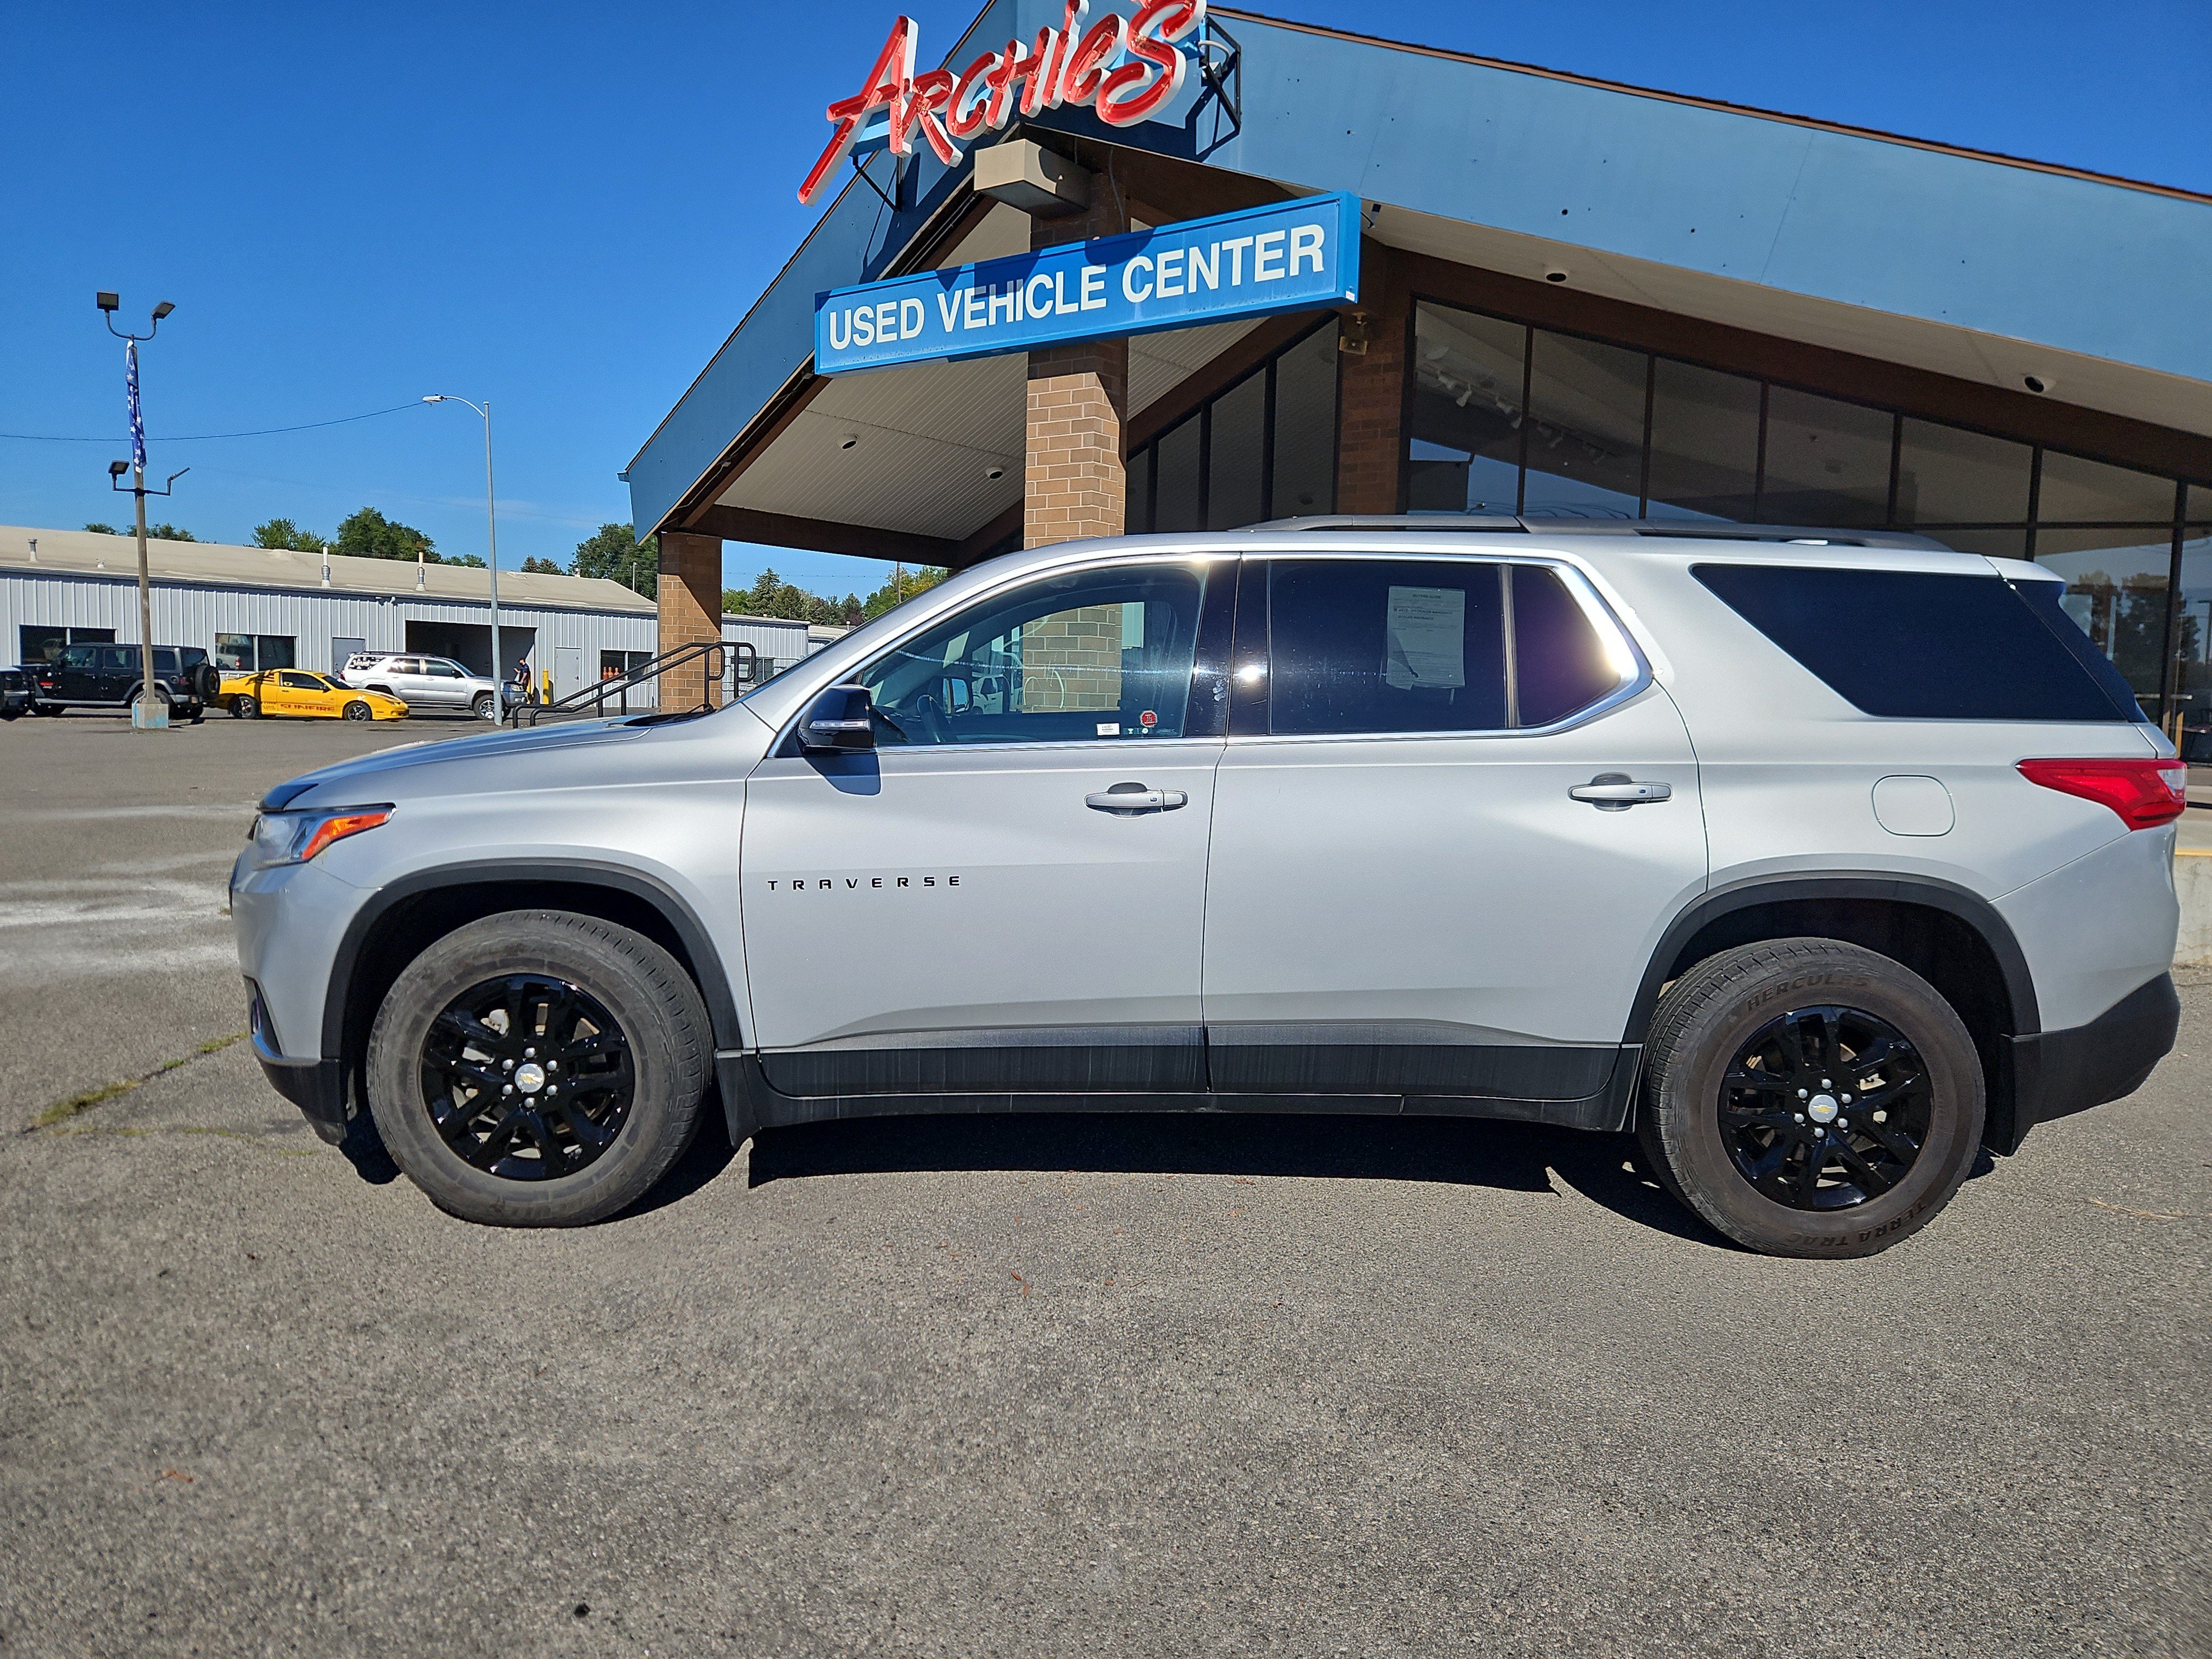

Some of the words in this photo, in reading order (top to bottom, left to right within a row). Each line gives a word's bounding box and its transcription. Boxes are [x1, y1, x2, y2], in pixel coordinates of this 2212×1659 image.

[829, 298, 924, 350] USED
[937, 263, 1107, 332] VEHICLE
[1122, 224, 1324, 304] CENTER
[280, 704, 336, 712] SUNFIRE
[768, 876, 960, 890] TRAVERSE
[1746, 975, 1867, 1012] HERCULES
[1858, 1200, 1926, 1243] TERRA
